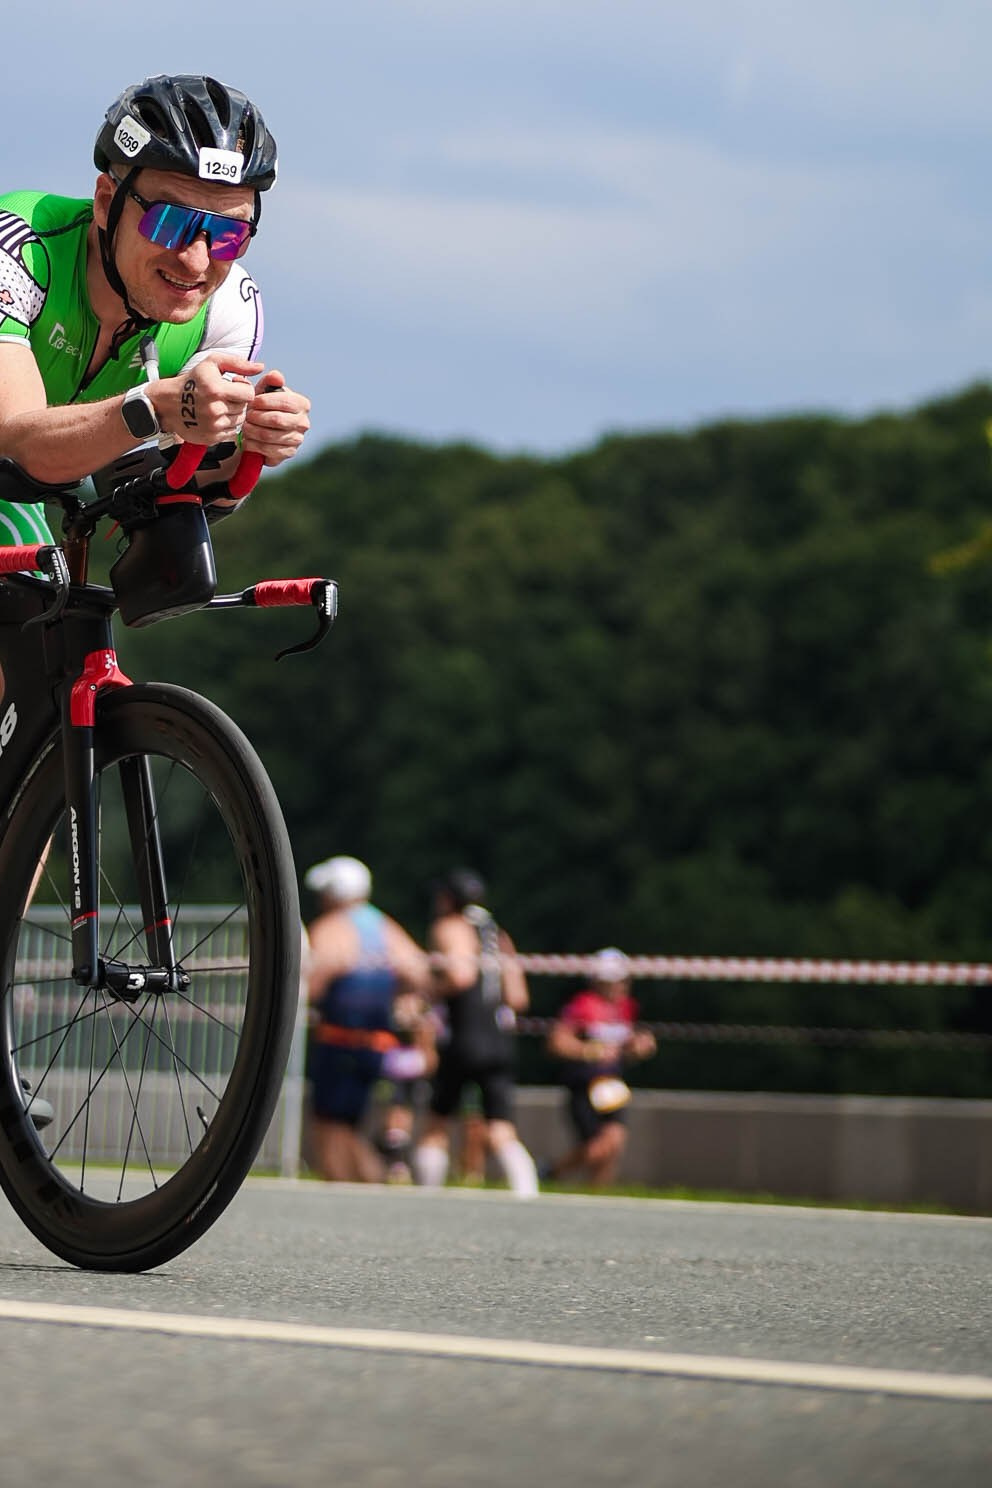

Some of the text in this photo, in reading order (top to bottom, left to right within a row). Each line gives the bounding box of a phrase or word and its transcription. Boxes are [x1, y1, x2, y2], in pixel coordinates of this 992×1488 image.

[118, 129, 139, 153] 1259
[205, 162, 237, 178] 1259
[181, 379, 198, 429] 1259
[70, 806, 81, 884] ARGON
[74, 885, 82, 909] 18
